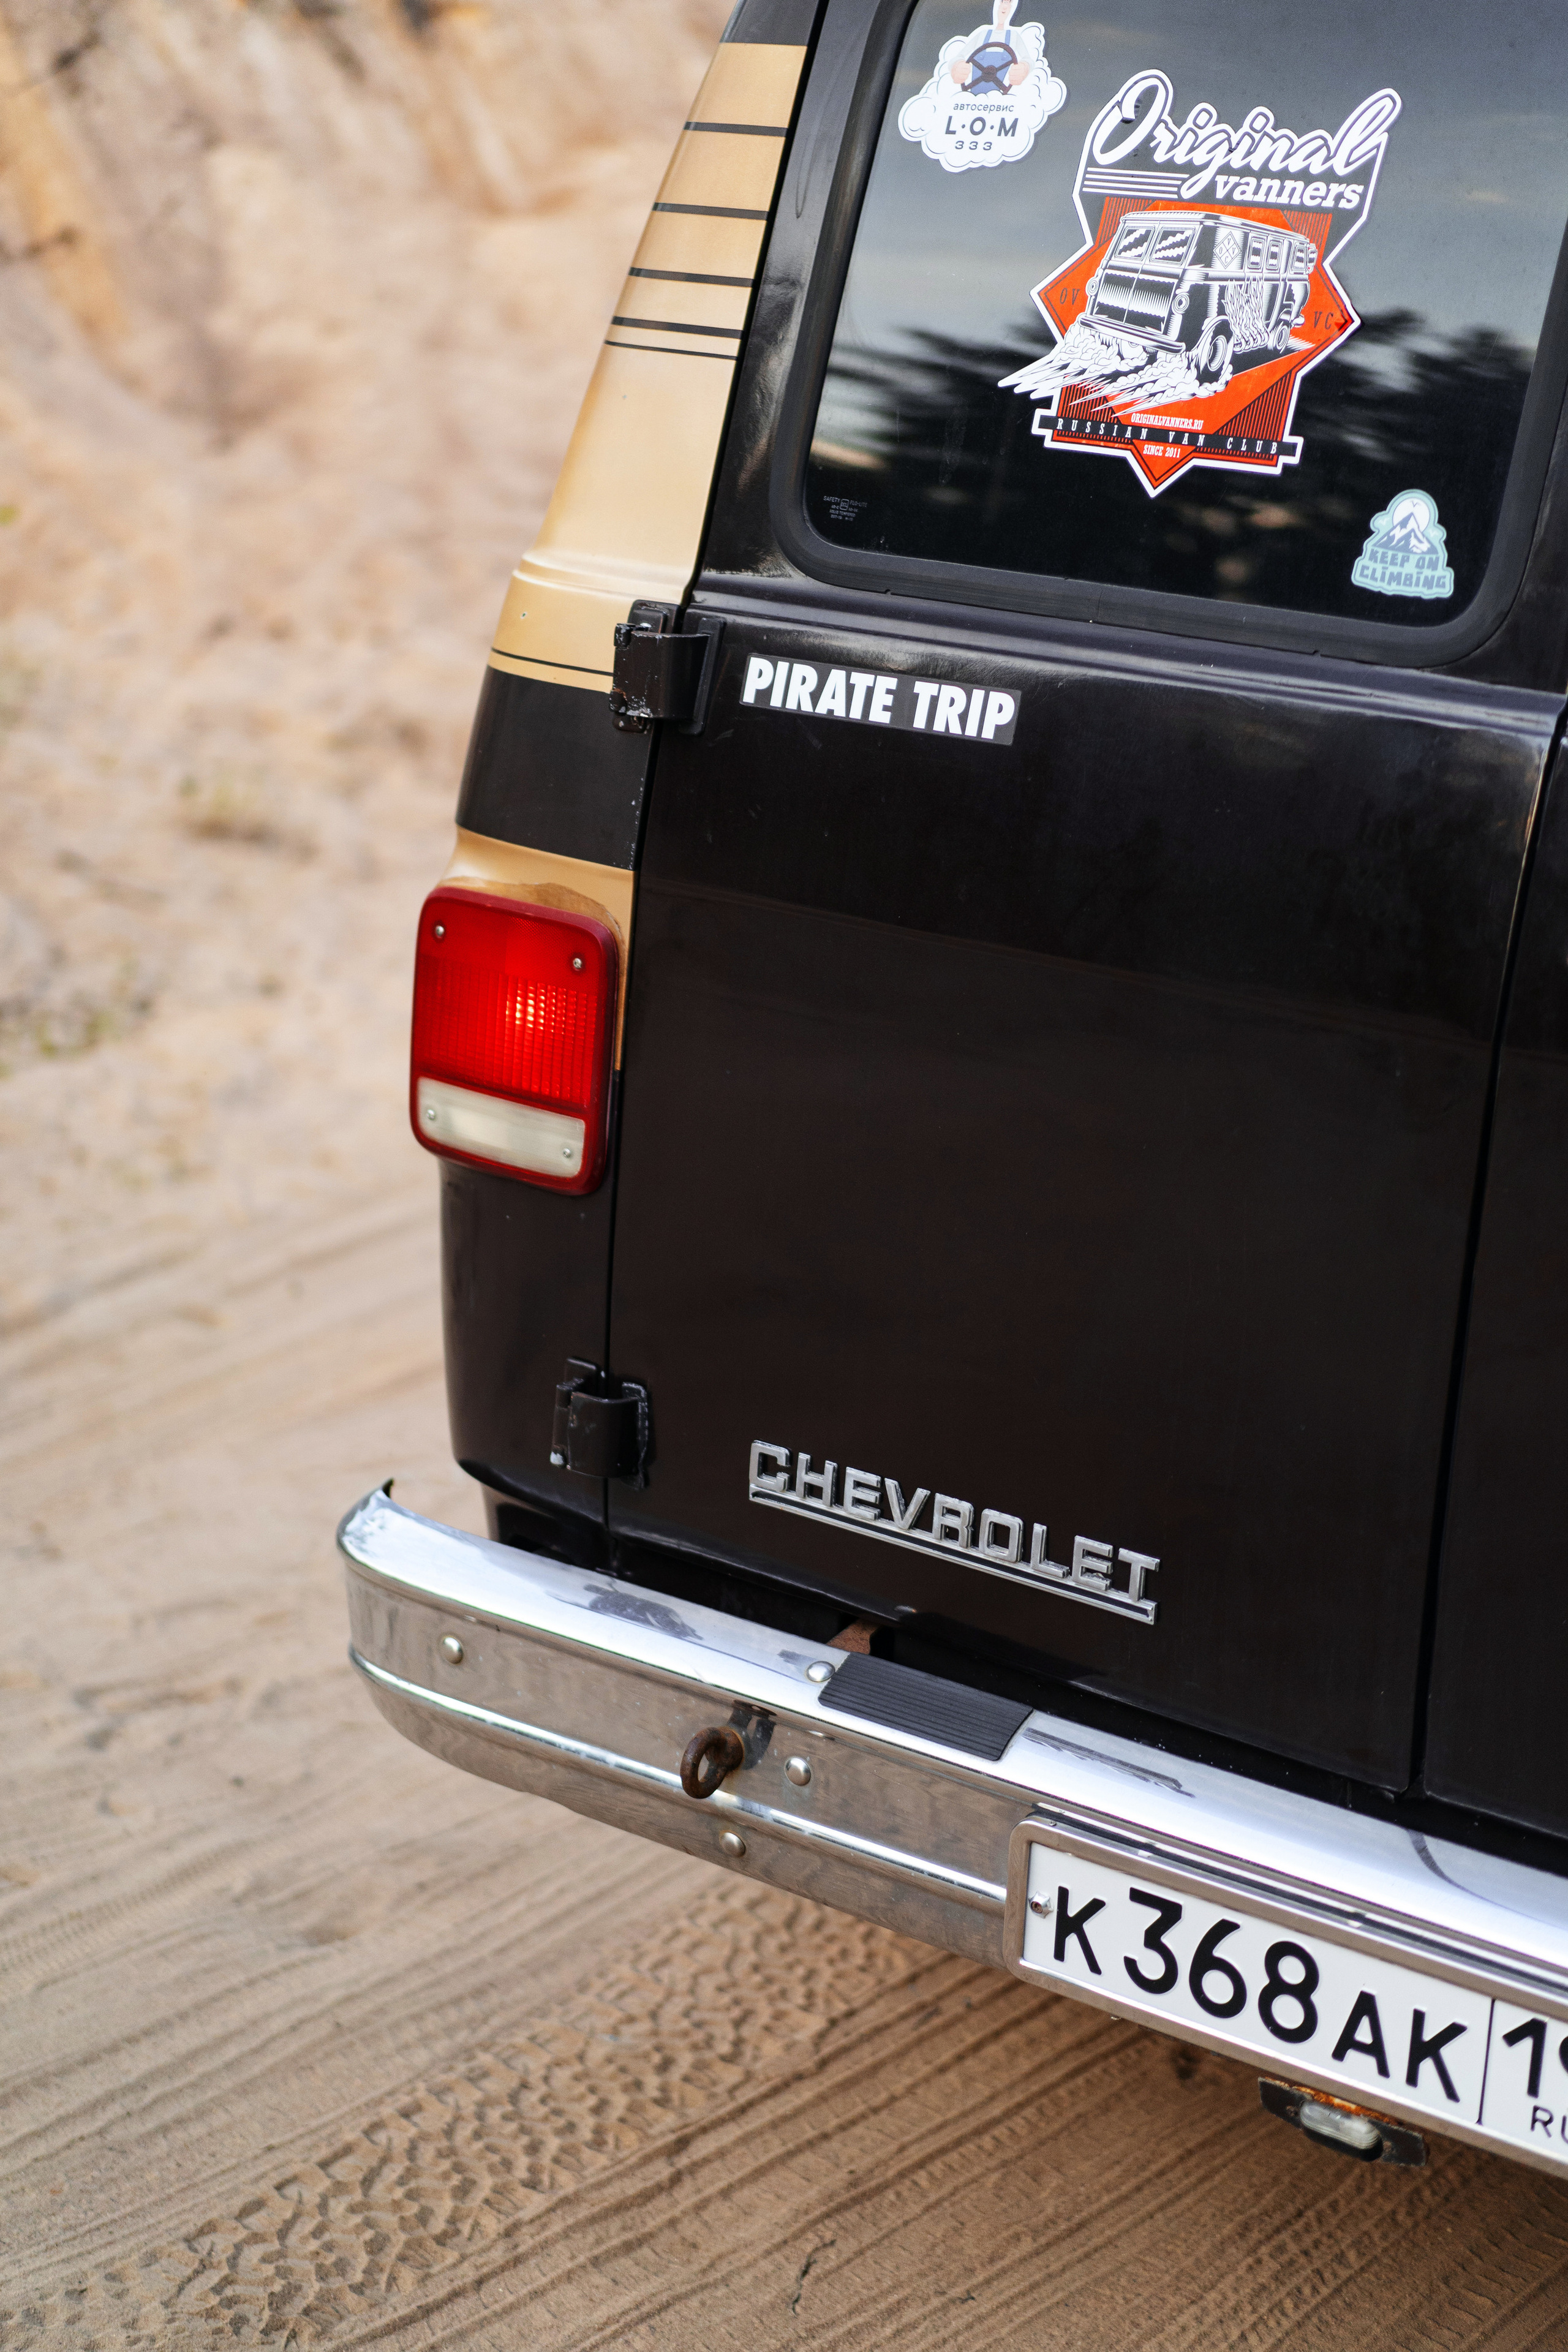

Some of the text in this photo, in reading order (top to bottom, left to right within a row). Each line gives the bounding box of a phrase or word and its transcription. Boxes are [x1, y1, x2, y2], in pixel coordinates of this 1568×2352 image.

[953, 103, 1014, 114] автосервис
[1092, 77, 1392, 199] Original
[1214, 174, 1365, 209] vanners
[1057, 418, 1278, 454] RUSSIAN VAN CLUB
[1131, 412, 1204, 430] ORIGINALVANNERS.RU
[1143, 444, 1181, 458] SINCE 2011
[1368, 548, 1440, 571] KEEP ON
[742, 657, 1016, 740] PIRATE TRIP
[748, 1439, 1161, 1602] CHEVROLET
[1502, 2017, 1568, 2099] 1
